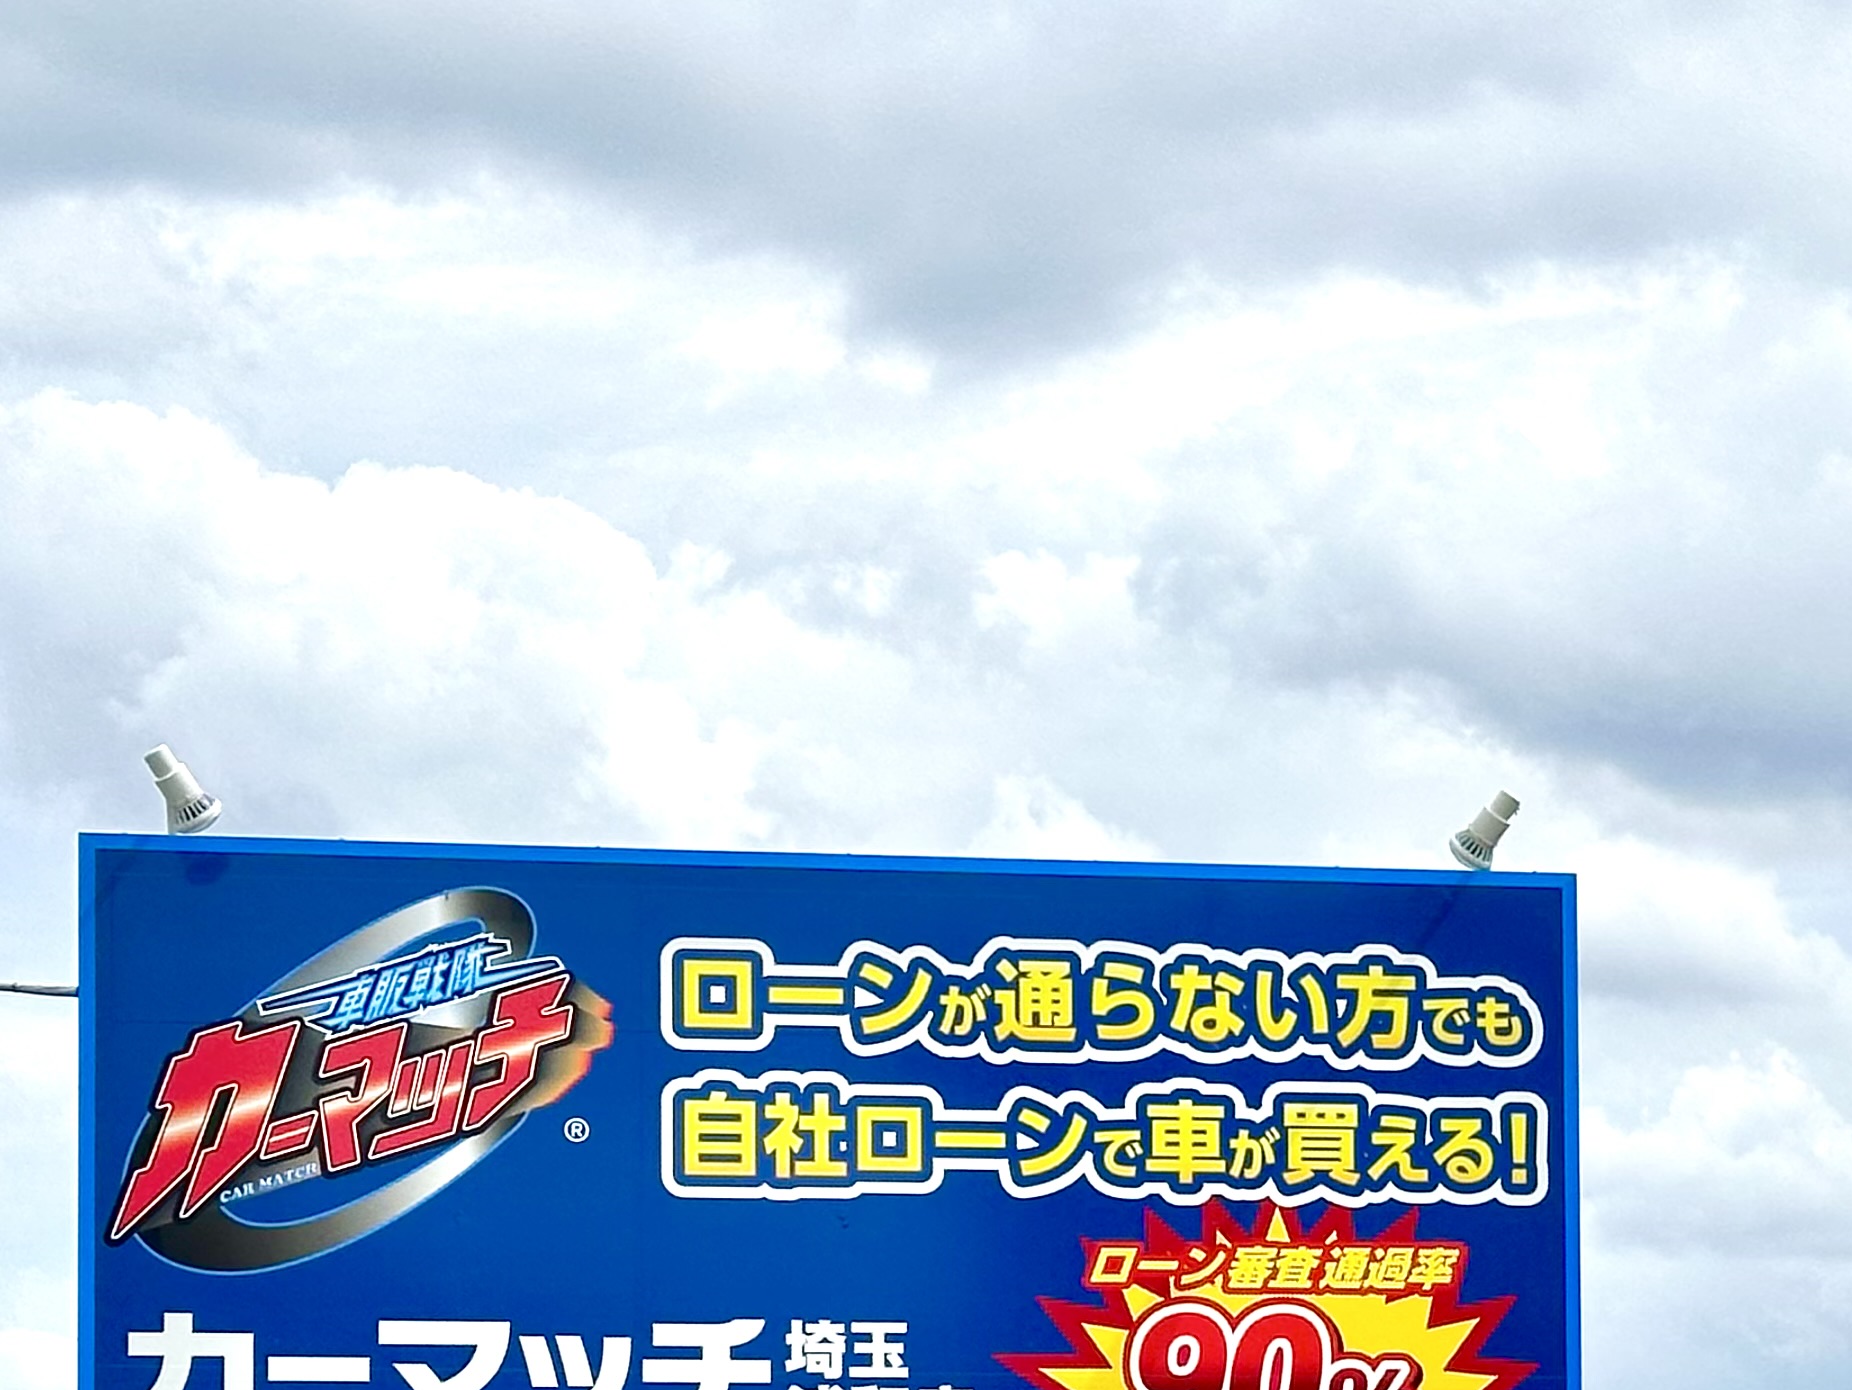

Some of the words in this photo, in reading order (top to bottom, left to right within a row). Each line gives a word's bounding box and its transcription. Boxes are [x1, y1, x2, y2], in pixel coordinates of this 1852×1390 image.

[336, 942, 488, 1028] 車販戦隊
[680, 954, 1527, 1054] ローンが通らない方でも
[106, 974, 575, 1240] カーマッチ
[219, 1182, 255, 1203] CAR
[784, 1320, 910, 1380] 埼玉
